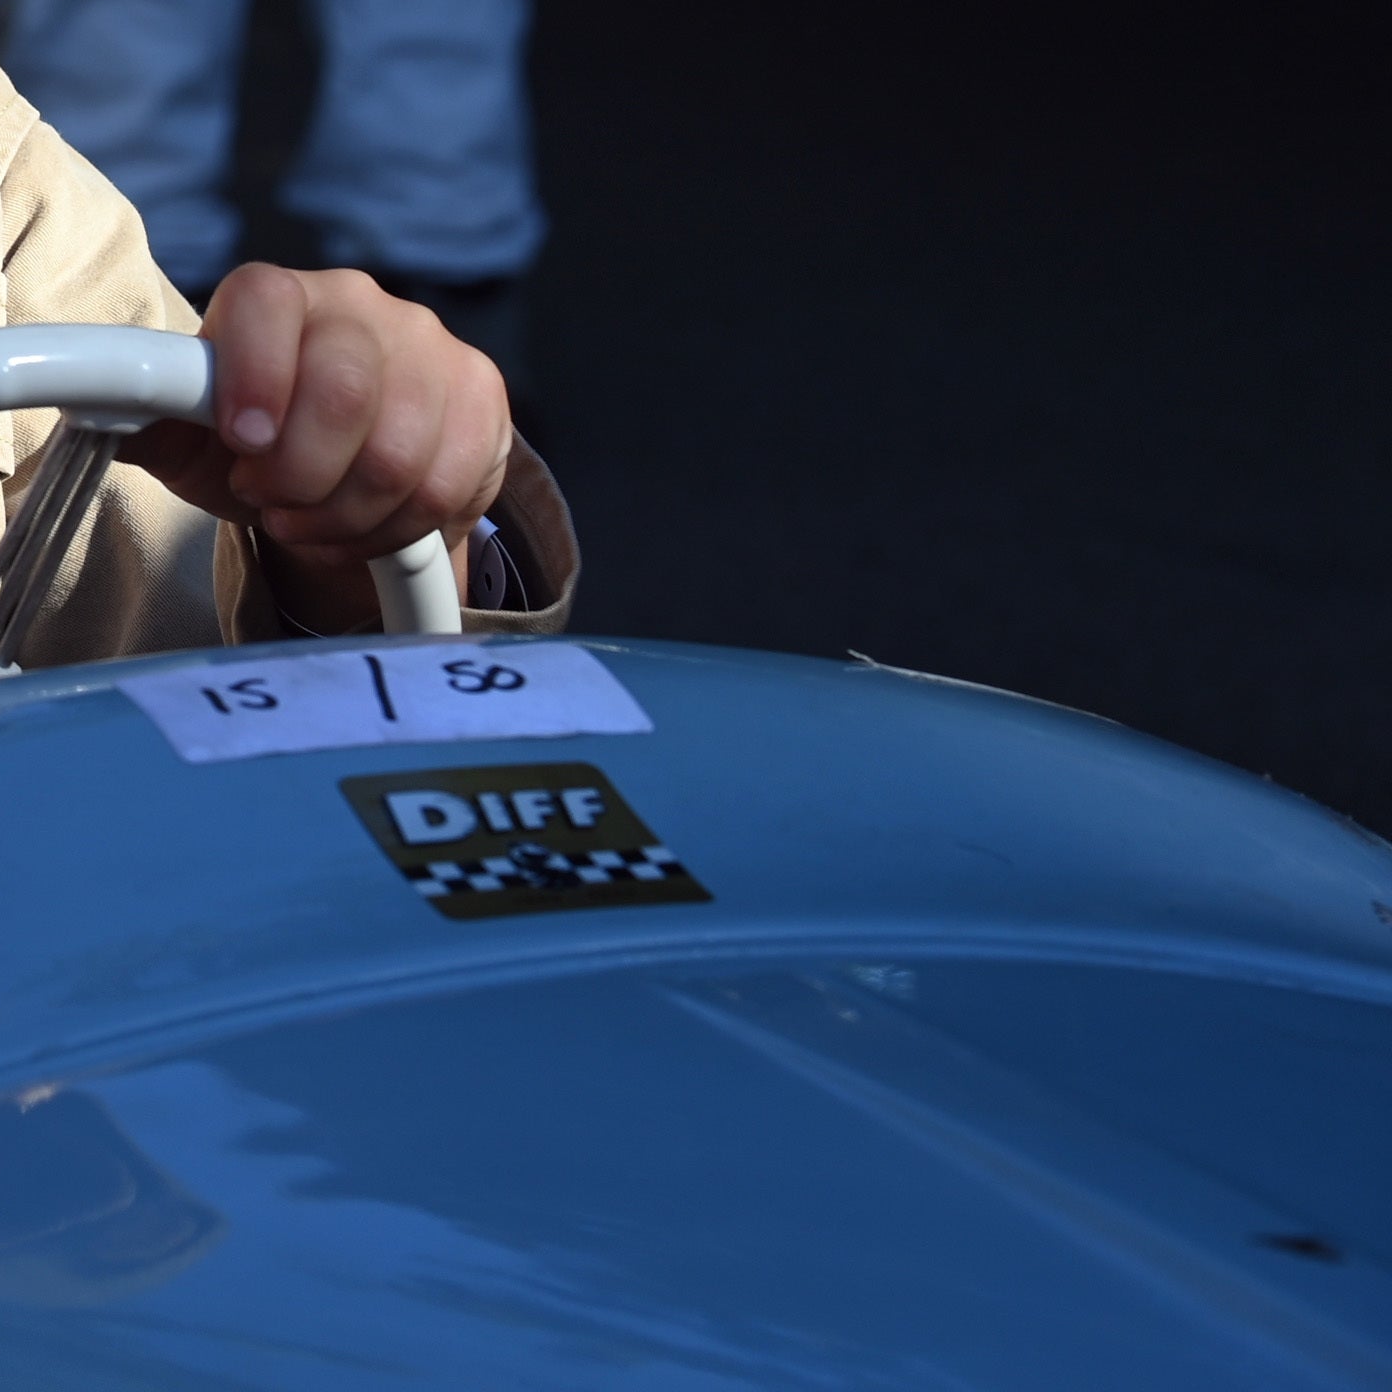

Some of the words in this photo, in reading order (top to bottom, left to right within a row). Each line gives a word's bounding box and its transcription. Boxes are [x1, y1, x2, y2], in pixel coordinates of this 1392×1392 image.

[200, 678, 279, 715] 15
[442, 659, 527, 694] 50
[384, 788, 604, 844] DIFF
